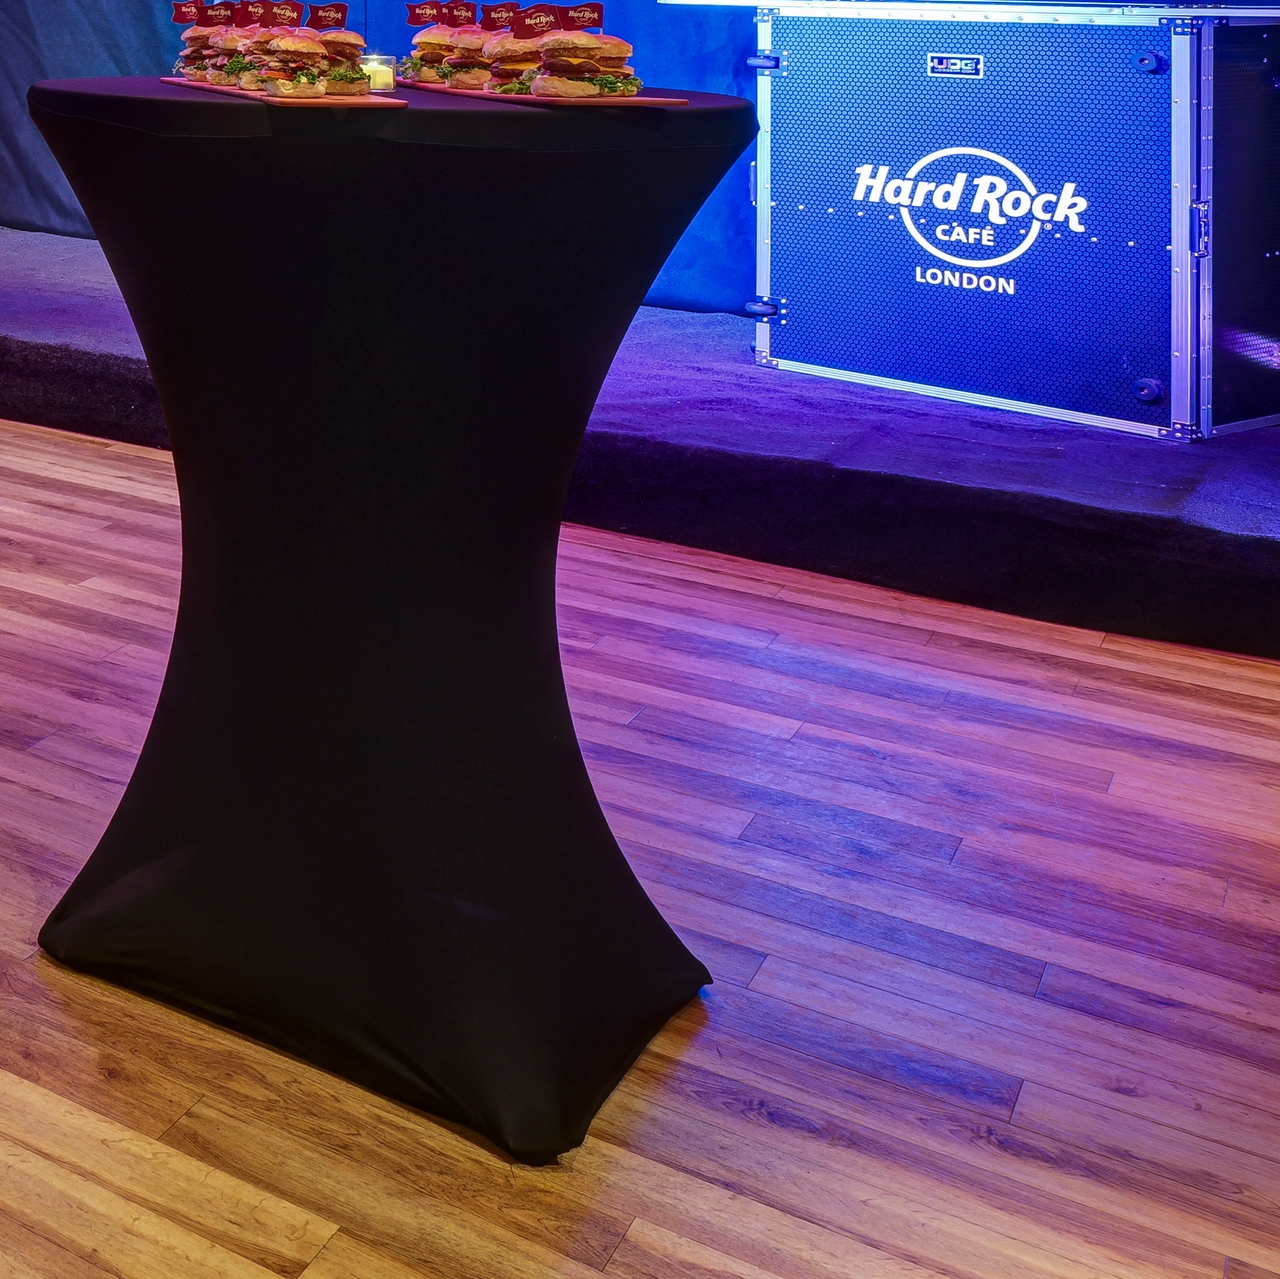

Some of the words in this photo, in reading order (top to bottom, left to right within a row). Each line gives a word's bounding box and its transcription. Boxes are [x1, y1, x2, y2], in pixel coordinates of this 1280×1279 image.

[525, 16, 539, 25] Hard
[540, 14, 555, 23] Rock
[568, 10, 584, 18] Hard
[584, 12, 598, 20] Rock
[933, 58, 976, 69] UDG
[852, 163, 968, 211] Hard
[970, 174, 1089, 233] Rock
[915, 266, 1016, 295] LONDON
